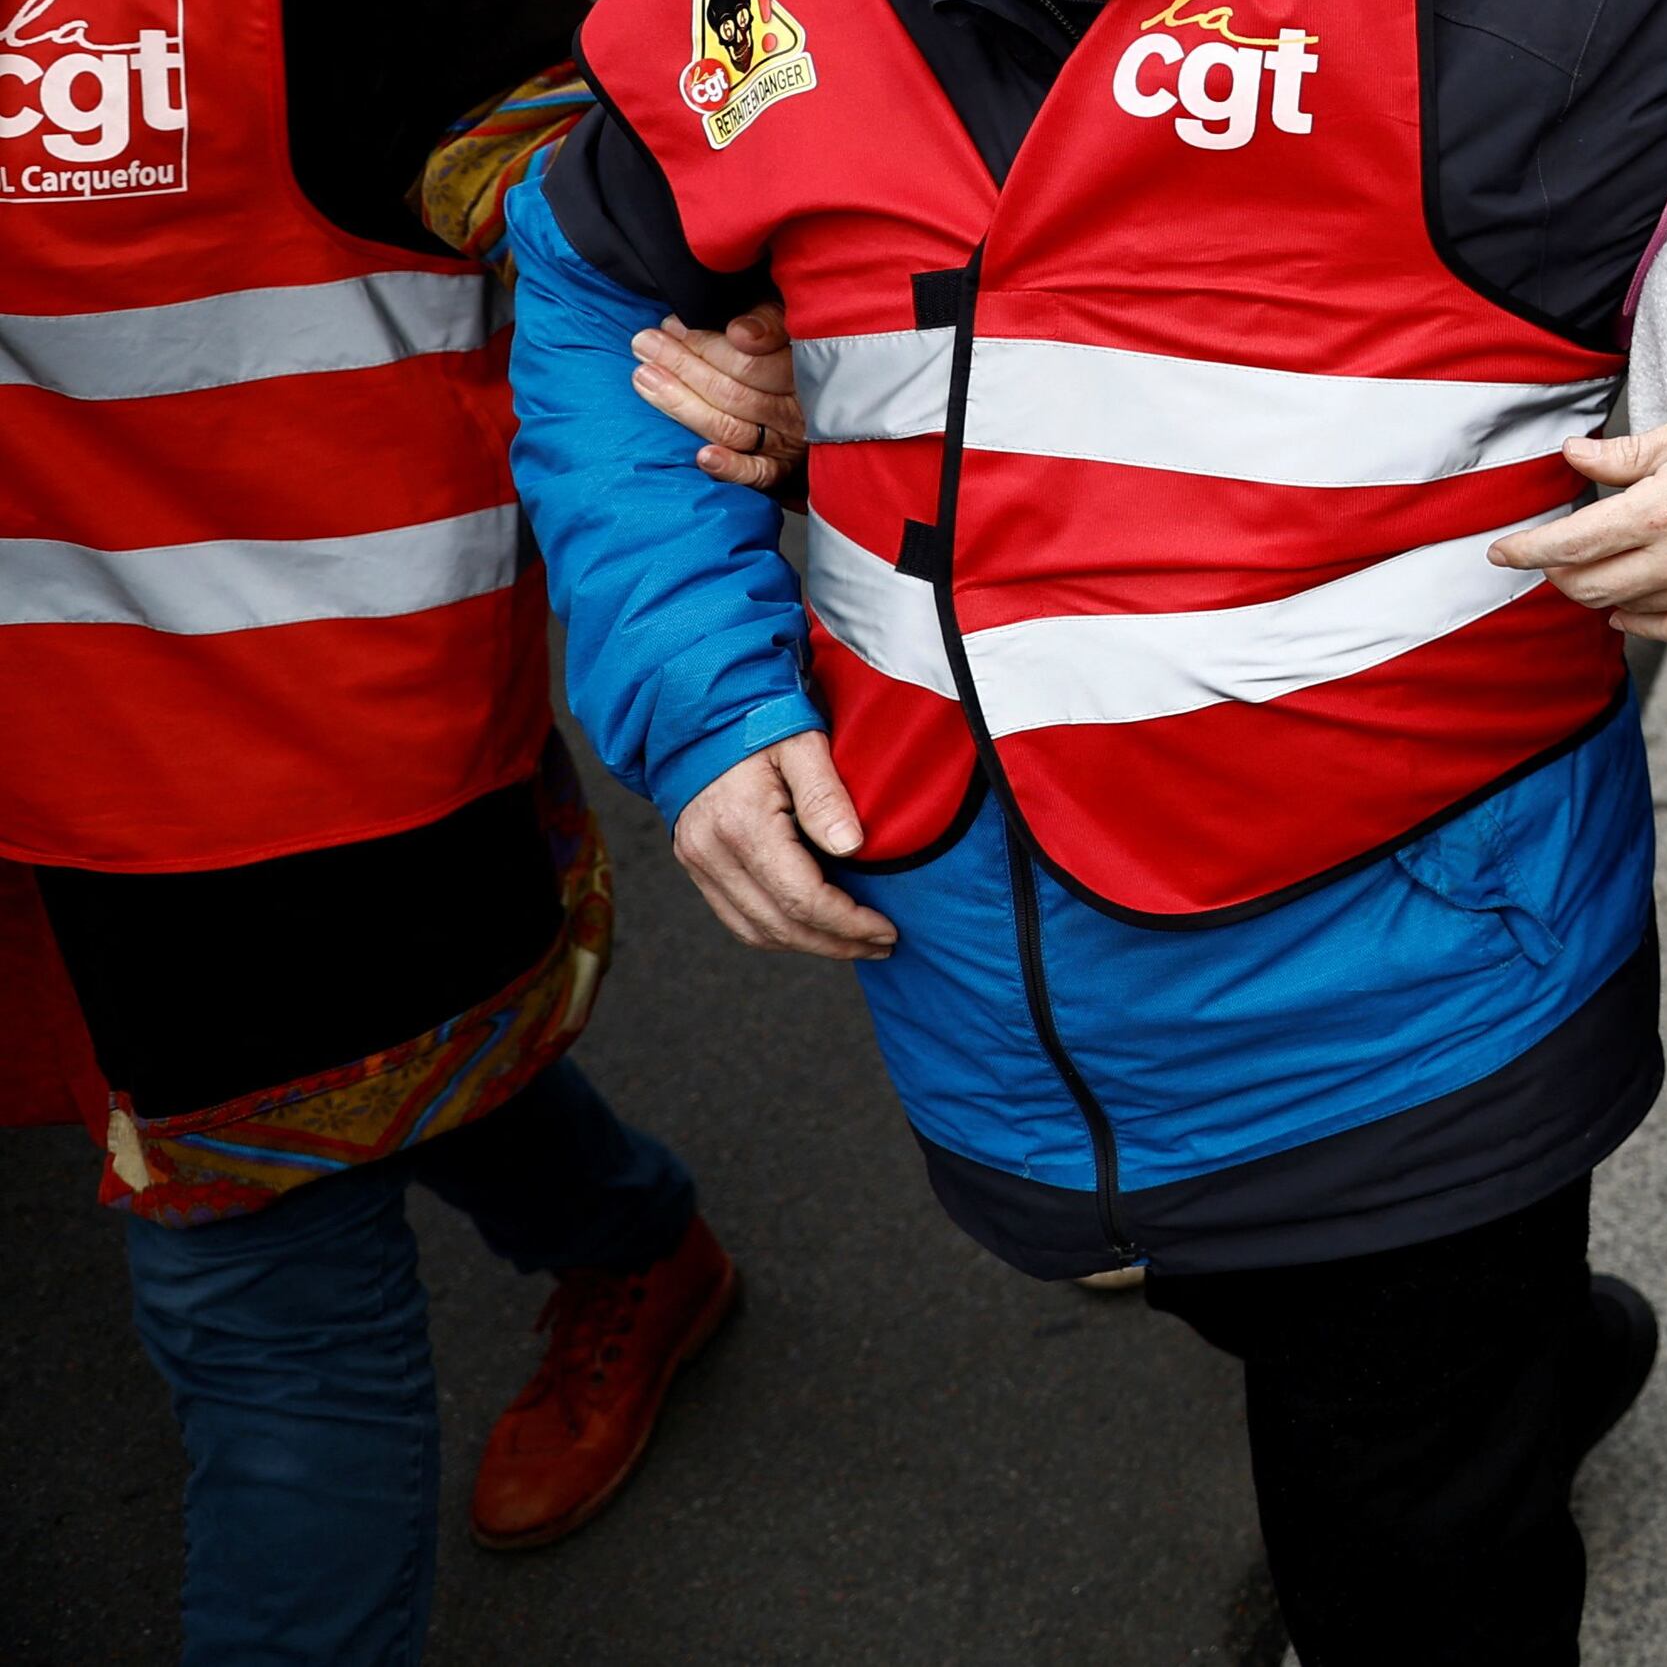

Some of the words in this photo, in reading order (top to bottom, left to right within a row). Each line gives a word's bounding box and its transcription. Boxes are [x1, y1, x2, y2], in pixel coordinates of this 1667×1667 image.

[0, 30, 185, 163] cgt
[691, 68, 729, 103] cgt
[715, 97, 753, 138] RETRAITE
[751, 89, 760, 110] EN
[759, 65, 805, 103] DANGER
[1112, 28, 1319, 150] cgt
[21, 160, 174, 197] Carquefou
